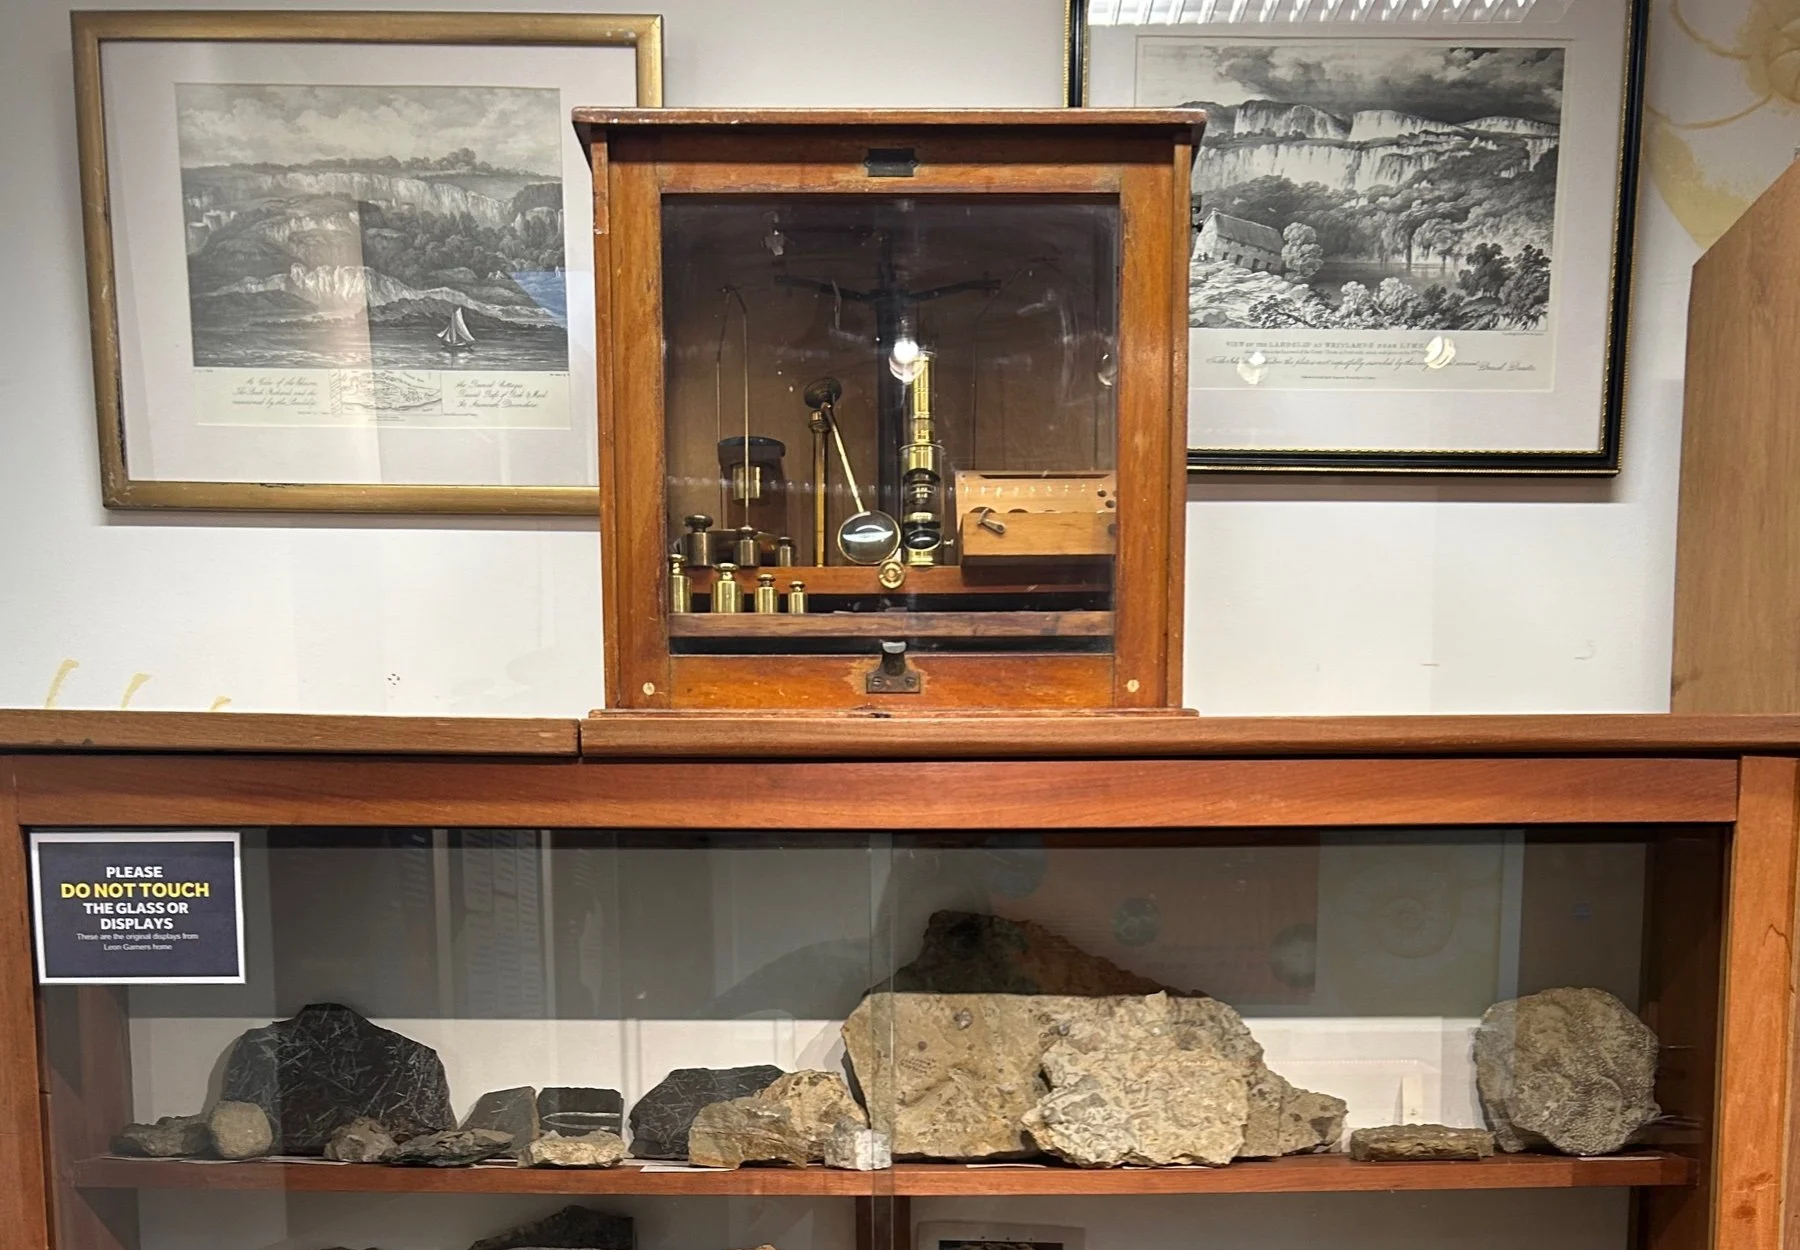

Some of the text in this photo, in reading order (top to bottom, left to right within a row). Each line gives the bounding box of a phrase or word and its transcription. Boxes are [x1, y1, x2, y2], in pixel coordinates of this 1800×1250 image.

[106, 866, 163, 878] PLEASE
[61, 882, 209, 898] DO NOT TOUCH
[83, 902, 189, 914] THE GLASS OR
[100, 918, 174, 930] DISPLAYS
[125, 933, 151, 942] original
[152, 933, 181, 942] displays
[103, 943, 122, 951] Leon
[152, 943, 173, 951] home
